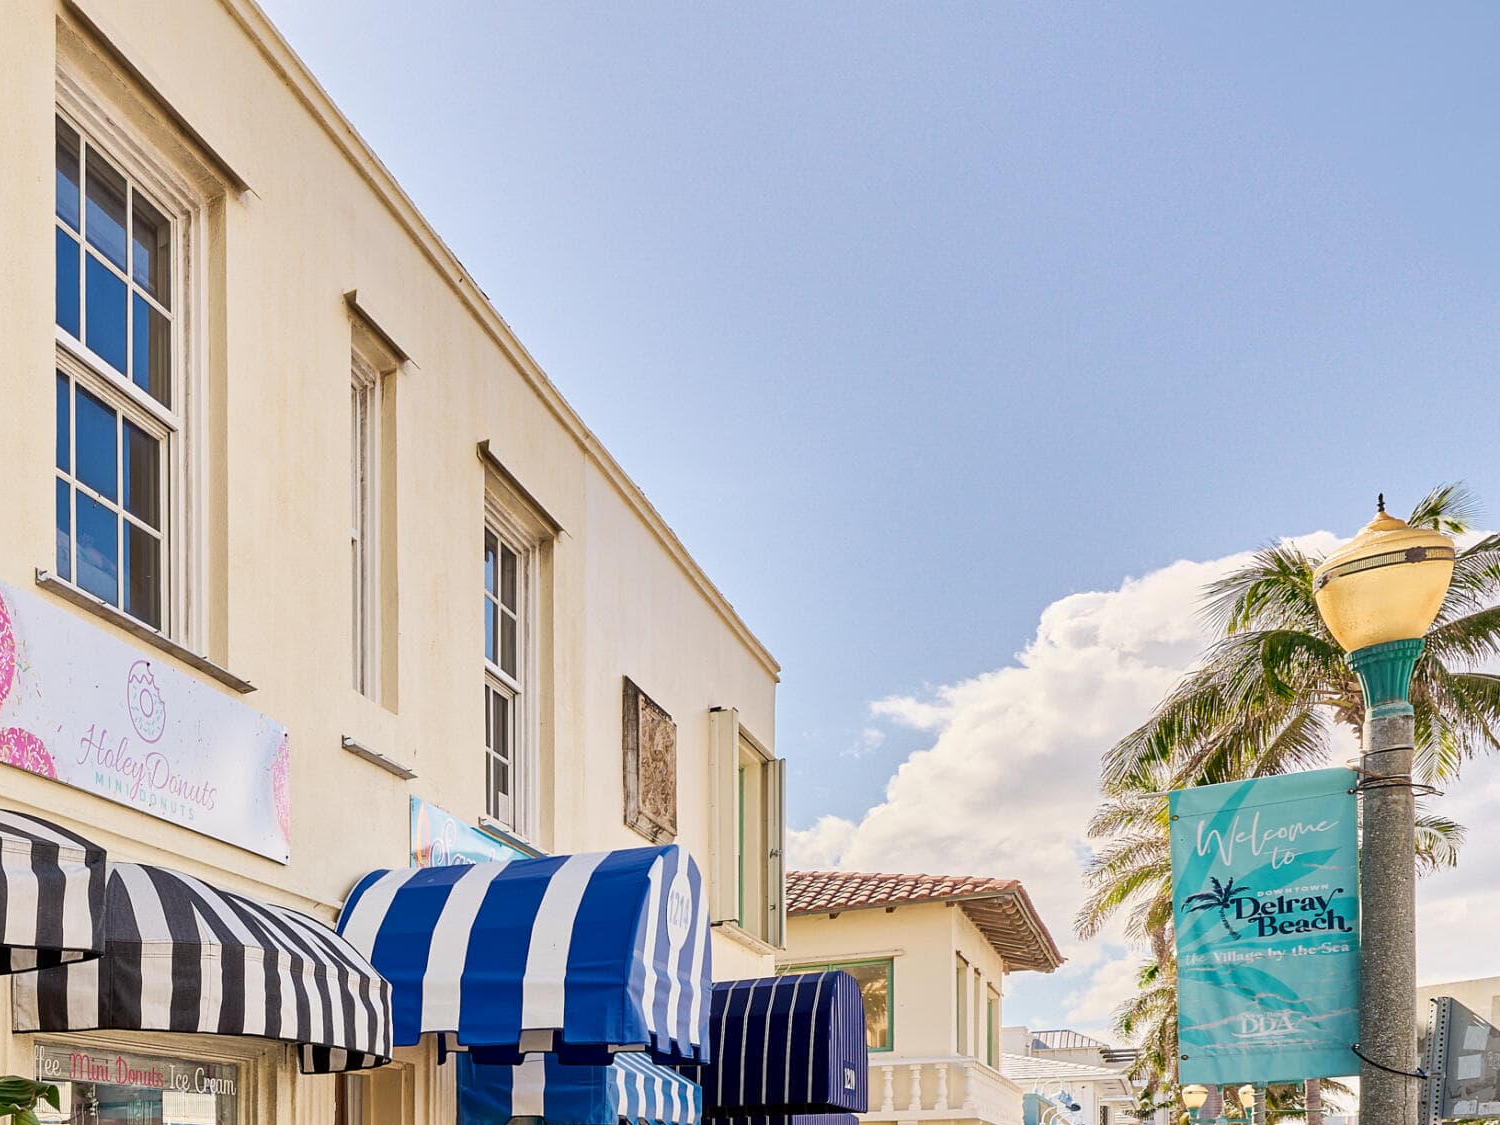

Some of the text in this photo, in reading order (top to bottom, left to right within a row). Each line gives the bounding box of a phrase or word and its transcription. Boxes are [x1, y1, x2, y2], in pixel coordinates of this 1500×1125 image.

[77, 723, 218, 811] Holey Donuts
[95, 771, 196, 821] MINI DONUTS
[1196, 811, 1339, 866] Welcome
[1263, 847, 1301, 870] to
[1230, 887, 1344, 921] Delray
[1256, 883, 1329, 898] DOWNTOWN
[1249, 910, 1353, 938] Beach
[1213, 951, 1264, 964] Village
[1267, 948, 1287, 961] by
[1291, 945, 1316, 956] the
[1321, 942, 1350, 954] Sea
[1240, 1015, 1296, 1034] DDA
[35, 1045, 236, 1096] ffee Mini Donuts Ice Cream
